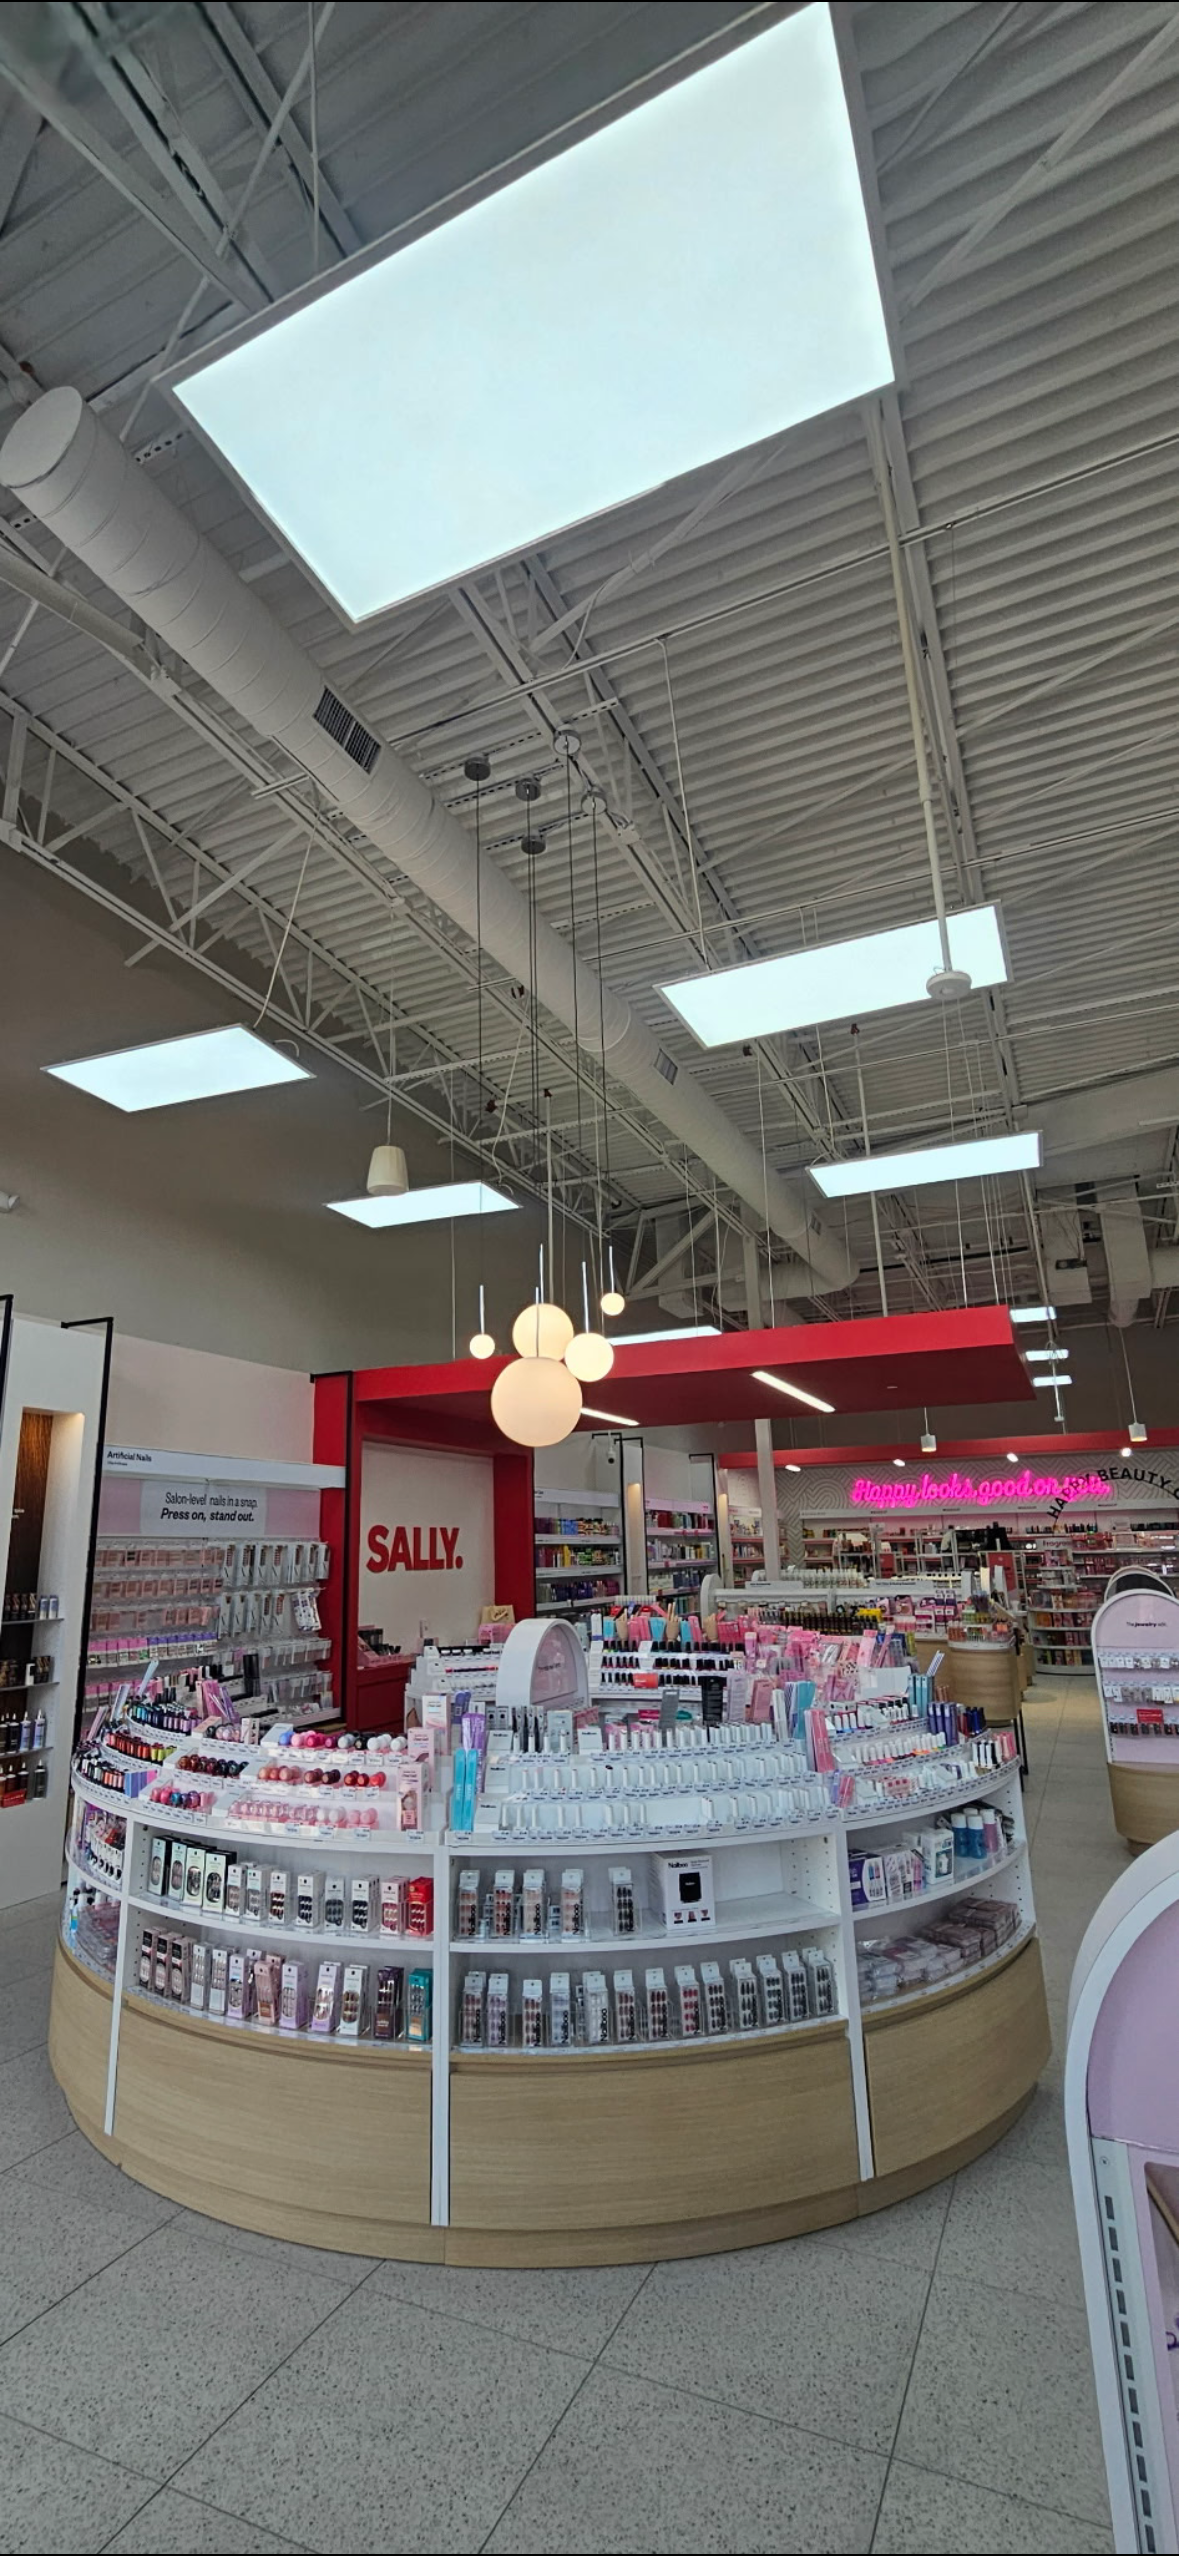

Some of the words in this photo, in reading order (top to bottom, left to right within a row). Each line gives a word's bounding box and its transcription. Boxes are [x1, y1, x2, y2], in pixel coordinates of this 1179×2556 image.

[107, 1451, 135, 1460] Artificial
[136, 1453, 152, 1462] Nails
[165, 1492, 207, 1506] Salon-level
[209, 1495, 226, 1507] nails
[227, 1496, 234, 1507] in
[234, 1499, 239, 1507] a
[240, 1499, 258, 1510] snap.
[853, 1479, 919, 1507] Happy
[920, 1473, 977, 1499] looks
[978, 1470, 1032, 1506] good
[1032, 1477, 1059, 1495] on
[1047, 1473, 1093, 1519] HAPPY
[1097, 1467, 1171, 1489] BEAUTY
[161, 1507, 190, 1520] Press
[191, 1511, 206, 1522] on,
[209, 1510, 237, 1521] stand
[237, 1513, 254, 1521] out.
[366, 1525, 463, 1573] SALLY.
